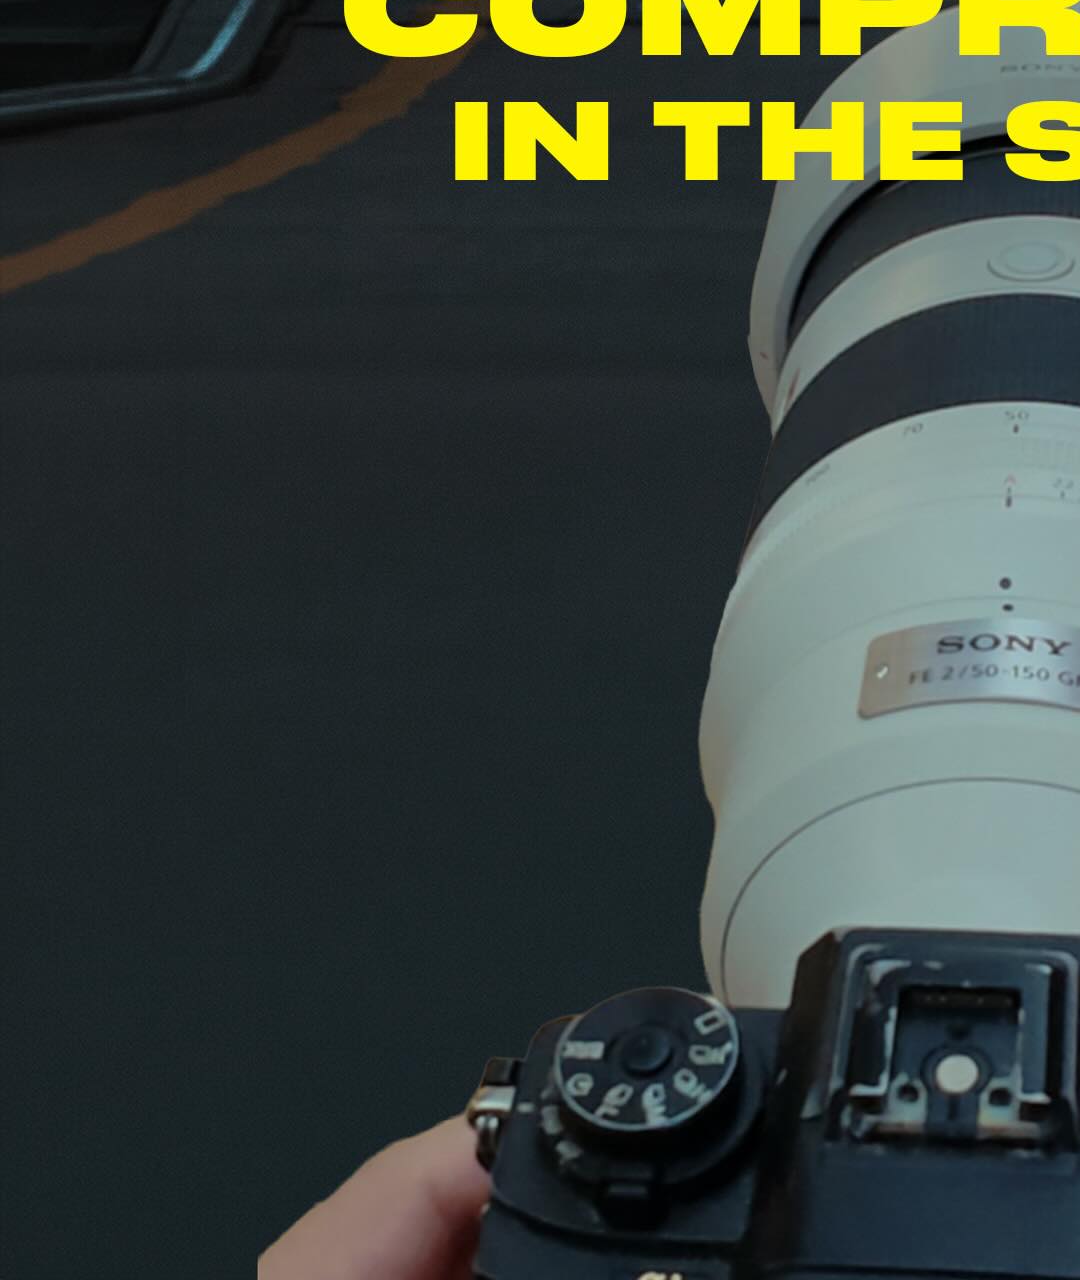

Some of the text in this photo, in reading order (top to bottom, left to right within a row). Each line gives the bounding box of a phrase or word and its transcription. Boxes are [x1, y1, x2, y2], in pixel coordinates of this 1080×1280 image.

[936, 633, 1072, 656] SONY
[909, 668, 931, 685] FE
[941, 663, 1049, 681] 2/50-150
